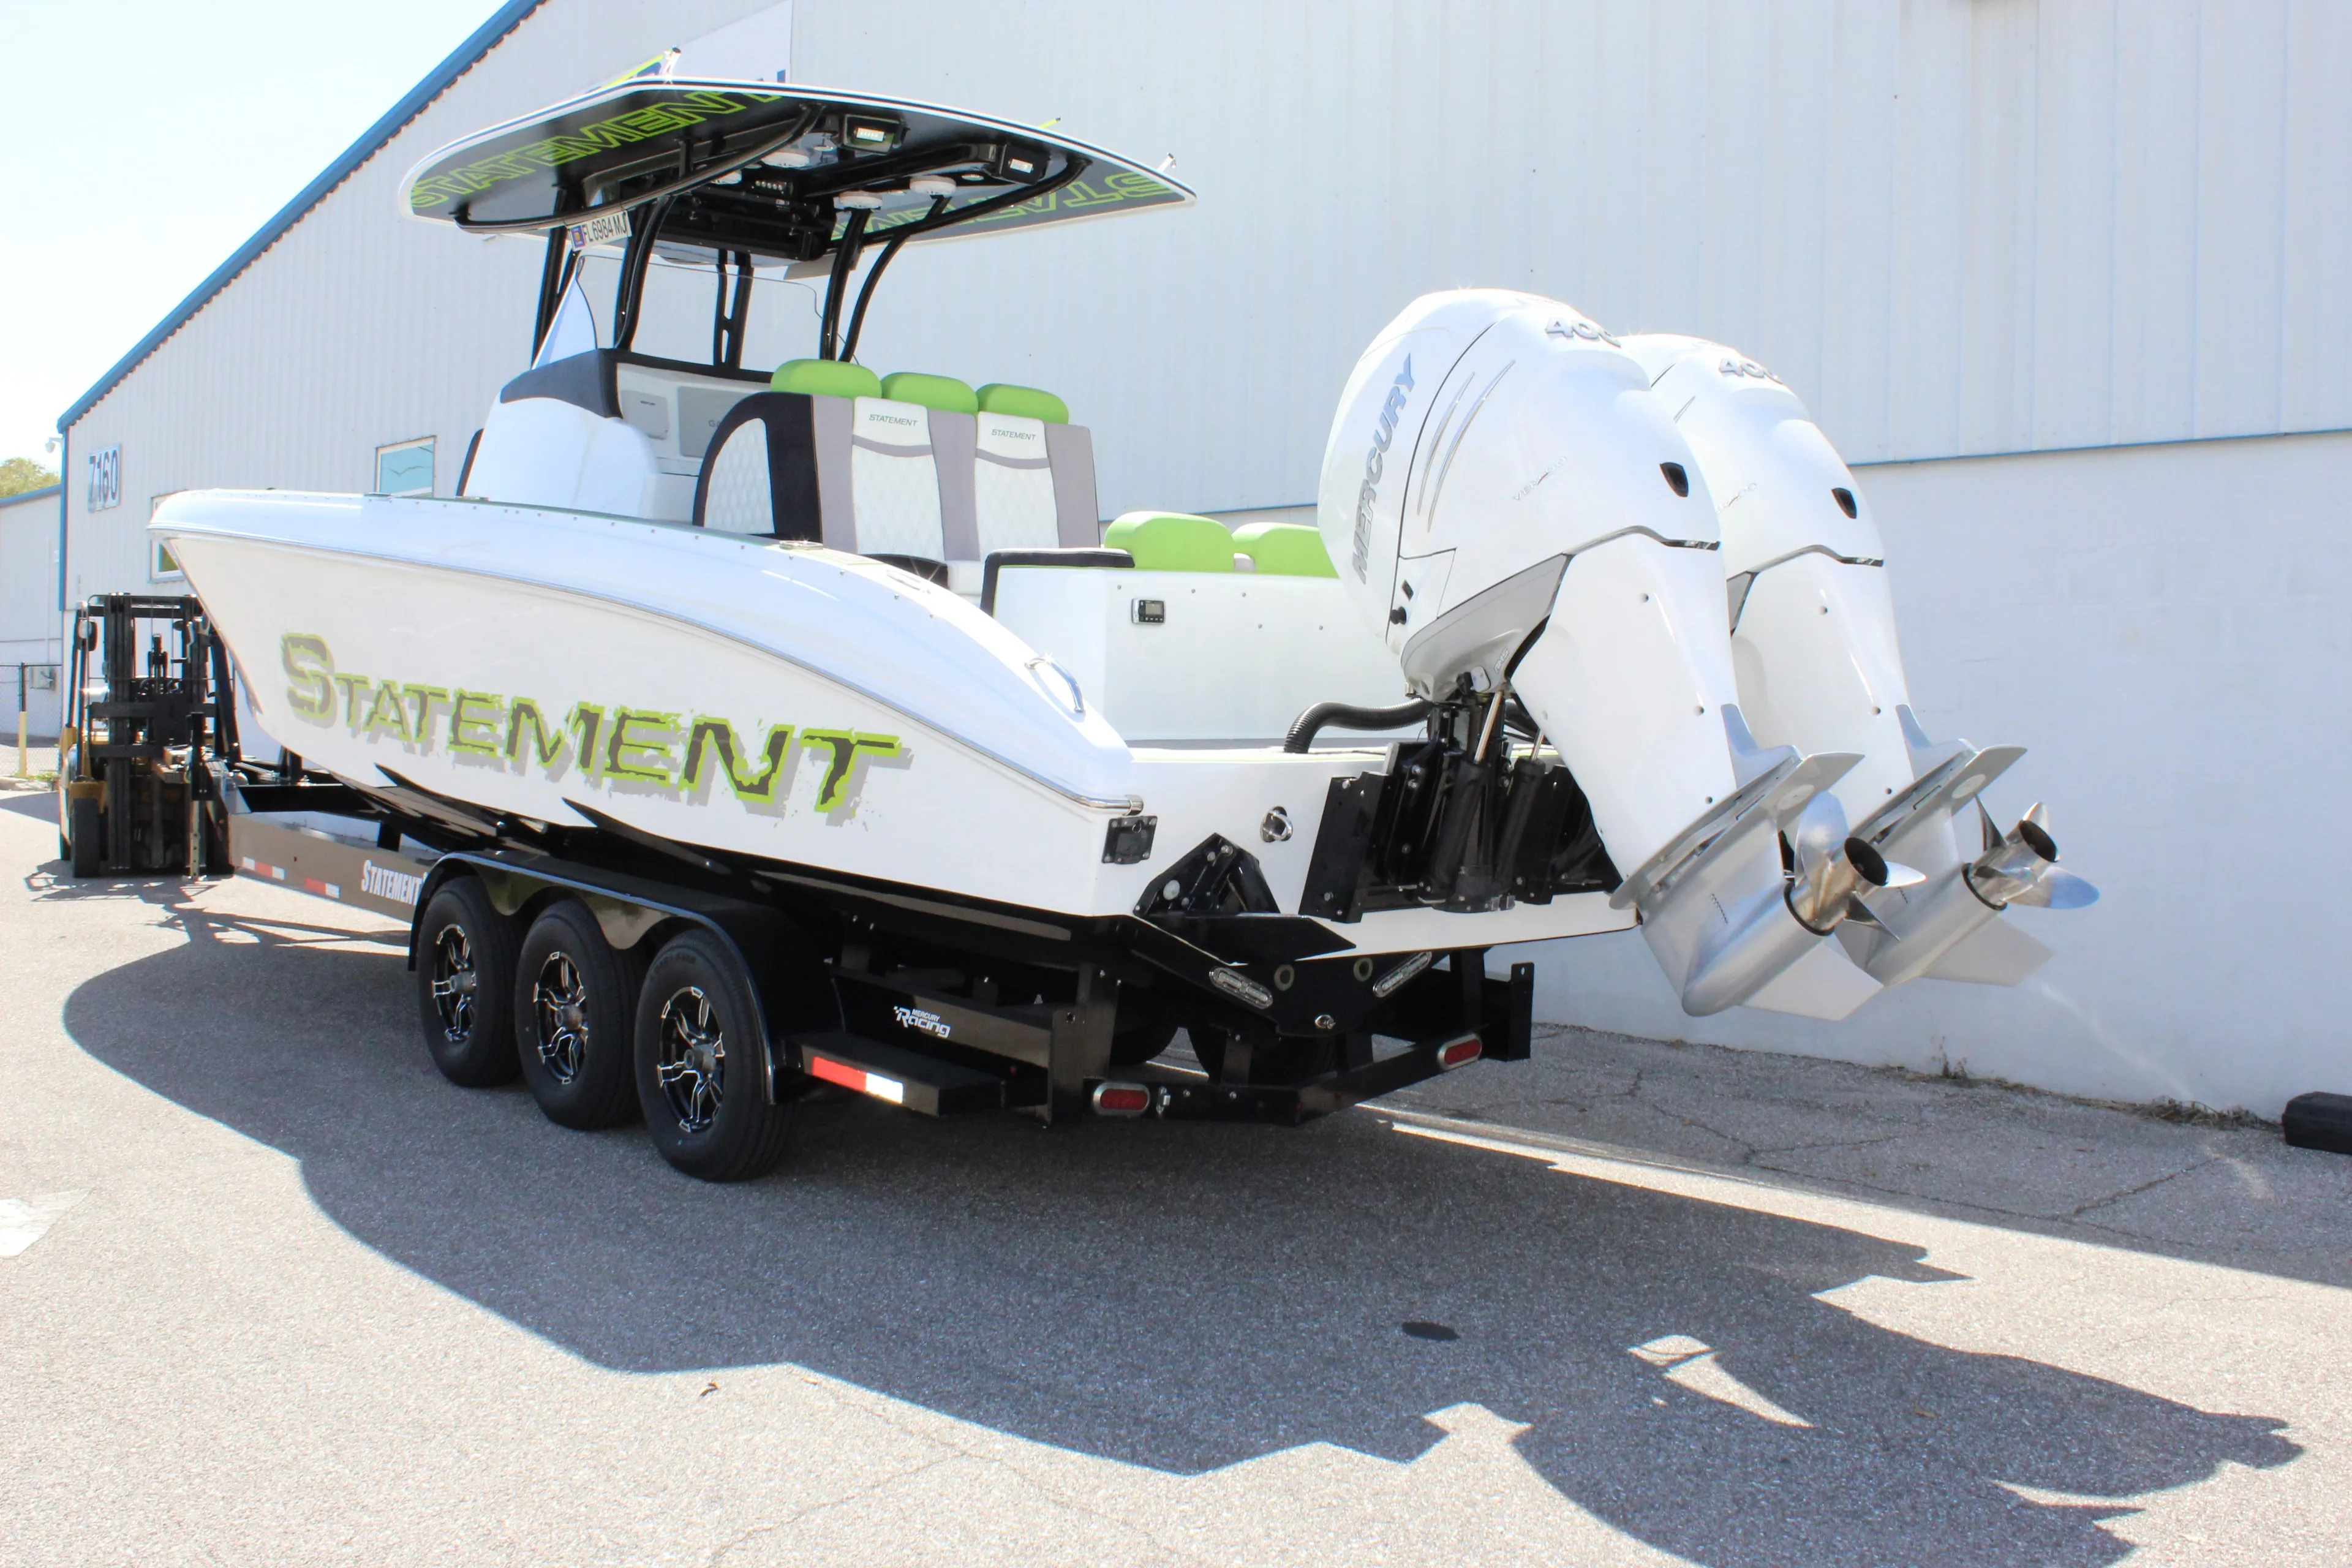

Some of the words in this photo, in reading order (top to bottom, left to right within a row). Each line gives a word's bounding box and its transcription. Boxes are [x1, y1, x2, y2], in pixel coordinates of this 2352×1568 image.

[410, 91, 782, 208] STATEMEN
[582, 224, 594, 244] FL
[592, 216, 614, 241] 6984
[612, 211, 628, 236] MJ
[869, 413, 919, 427] STATEMENT
[991, 429, 1037, 442] STATEMENT
[1352, 352, 1415, 586] MERCURY
[1512, 456, 1567, 500] VERADO
[1714, 482, 1757, 514] ERADO
[281, 631, 907, 820] STATEMENT
[361, 859, 423, 906] STATEMENT
[894, 1006, 951, 1039] Racing
[911, 1008, 940, 1022] MERCURY
